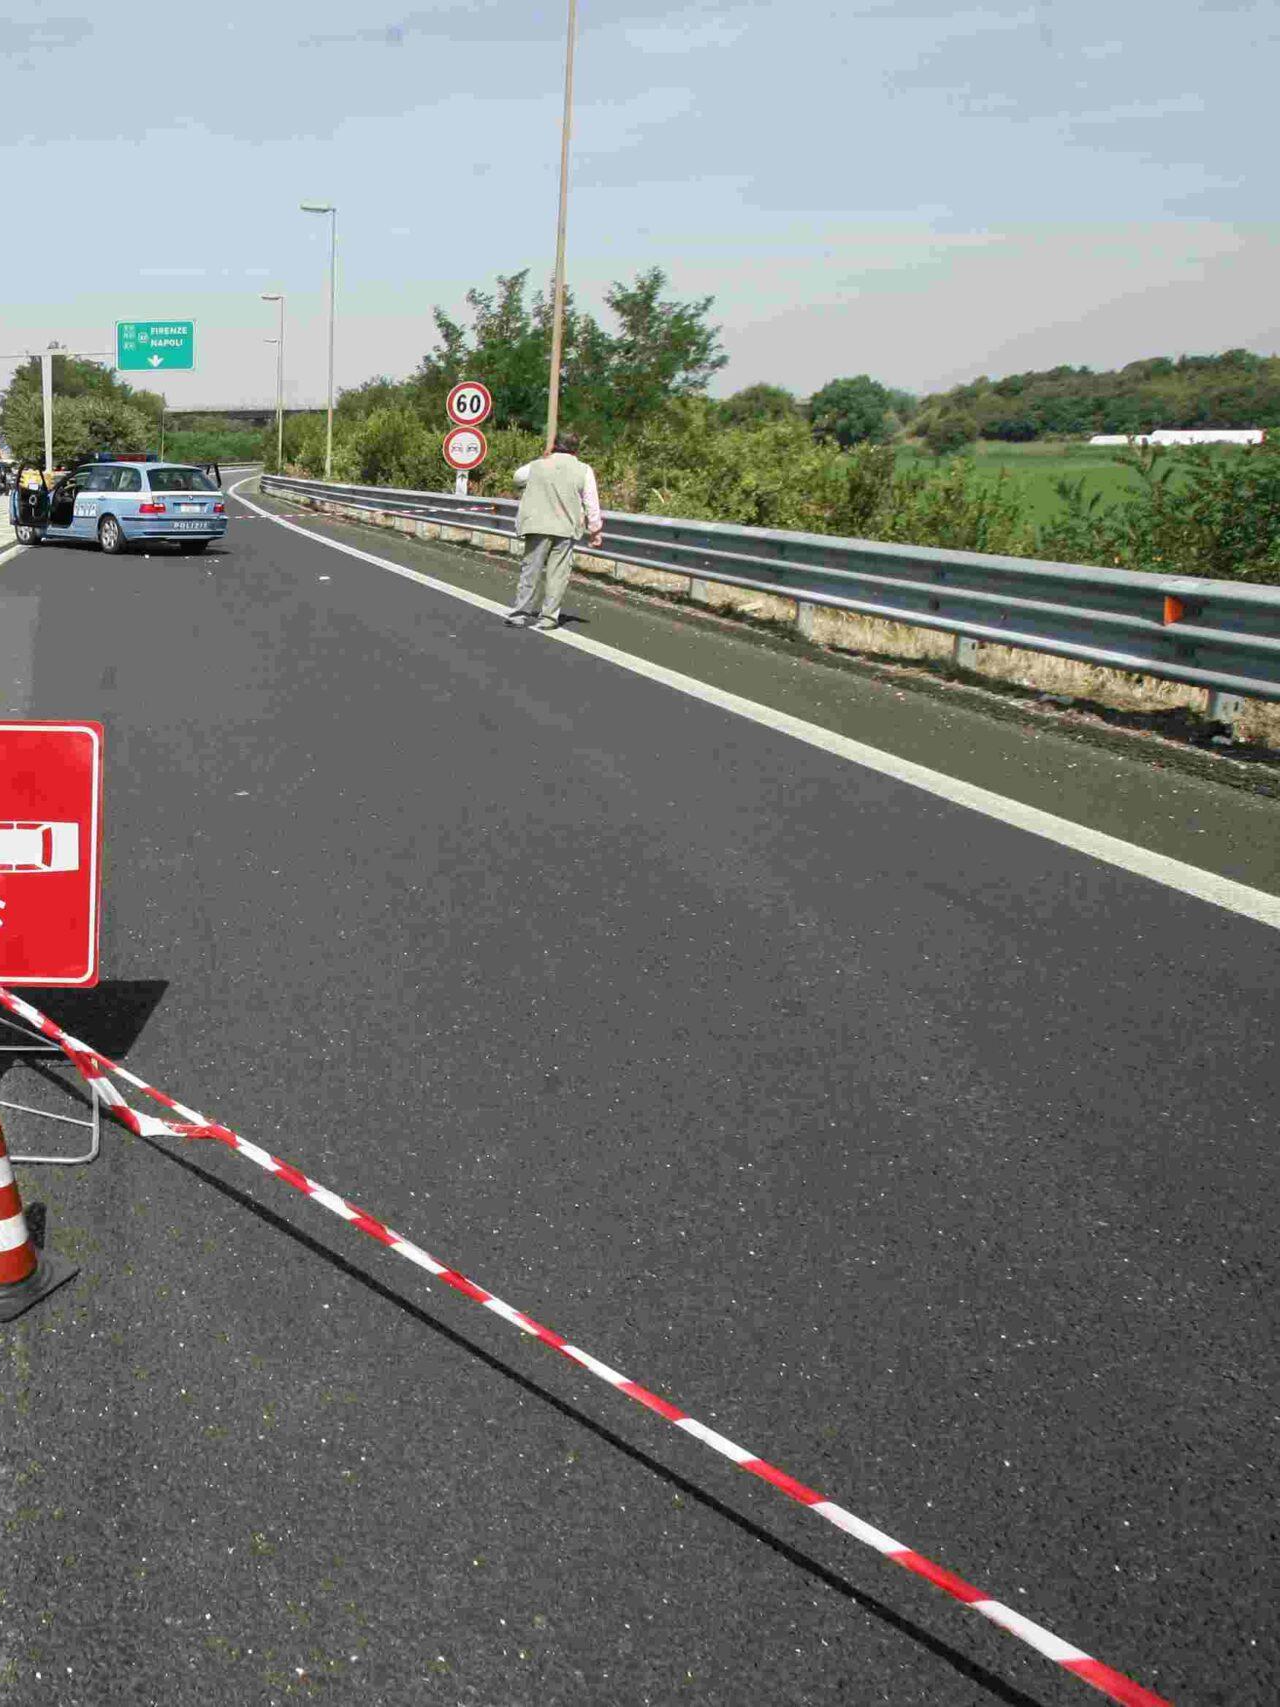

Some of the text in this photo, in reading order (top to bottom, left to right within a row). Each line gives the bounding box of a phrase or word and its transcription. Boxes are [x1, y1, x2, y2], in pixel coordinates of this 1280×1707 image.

[150, 326, 188, 335] FIRENZE
[150, 338, 183, 347] NAPOLI
[456, 394, 481, 413] 60
